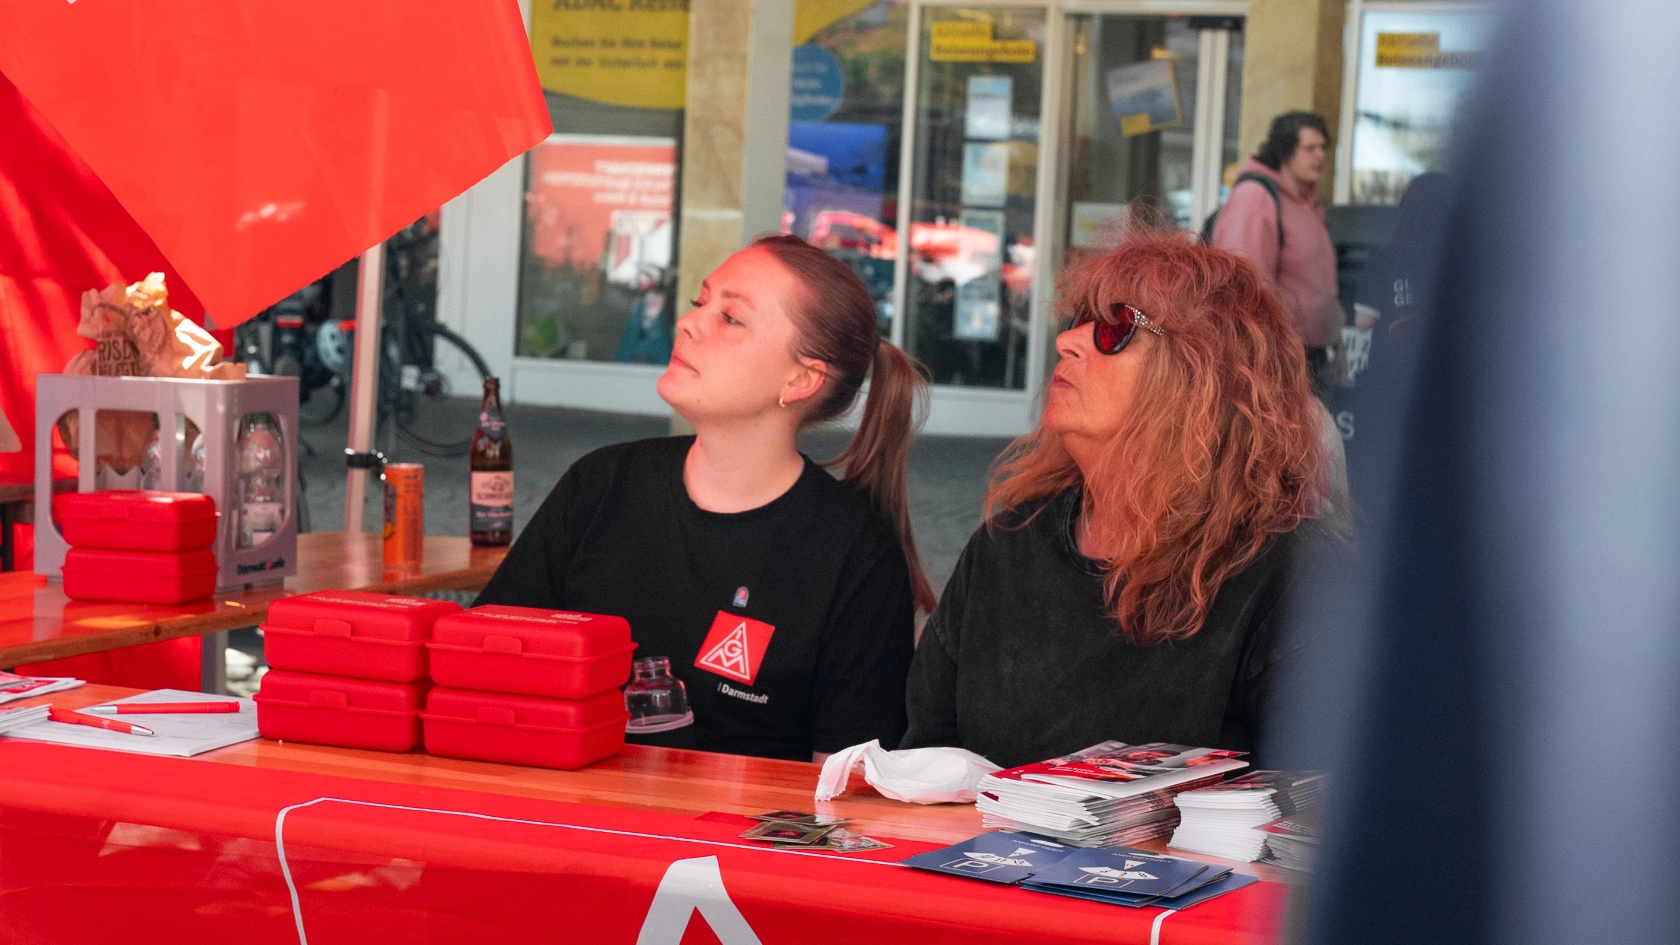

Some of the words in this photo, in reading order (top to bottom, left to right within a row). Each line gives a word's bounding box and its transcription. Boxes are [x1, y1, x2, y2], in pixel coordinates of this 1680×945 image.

[721, 684, 769, 704] Darmstadt
[952, 860, 989, 869] P
[1086, 876, 1120, 884] P
